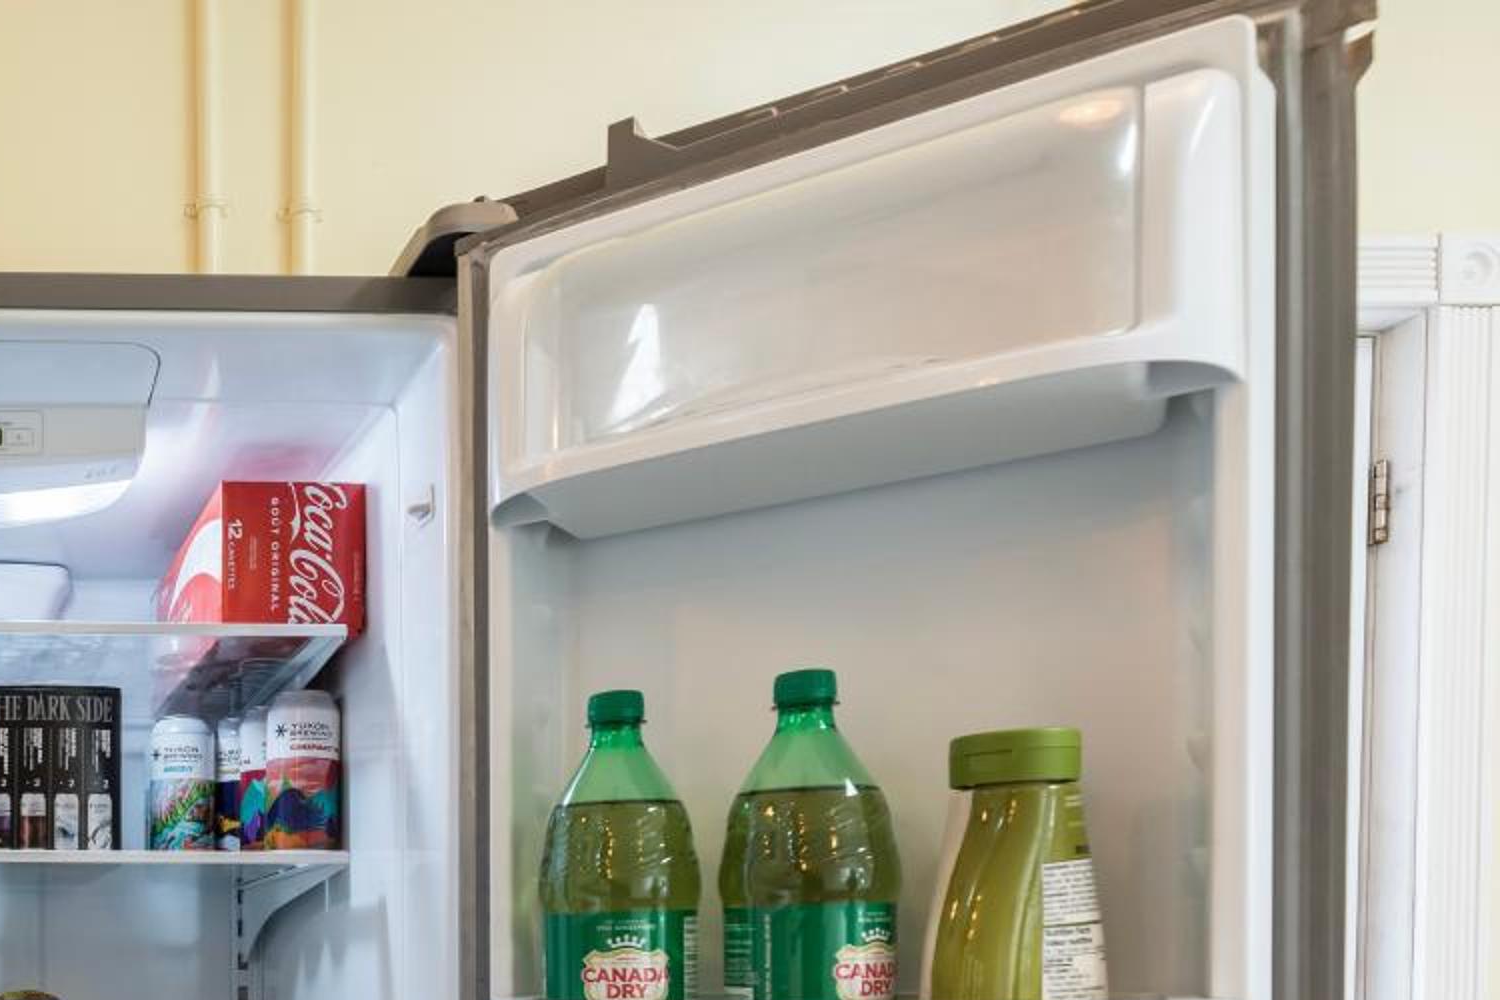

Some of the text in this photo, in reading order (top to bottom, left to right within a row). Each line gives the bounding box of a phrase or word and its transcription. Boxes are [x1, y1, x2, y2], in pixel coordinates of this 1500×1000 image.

[228, 519, 243, 540] 12
[271, 541, 280, 612] ORIGINAL
[27, 692, 71, 721] DARK
[76, 694, 114, 722] SIDE
[583, 966, 670, 983] CANADA
[607, 983, 648, 999] DRY
[861, 980, 892, 997] DRY
